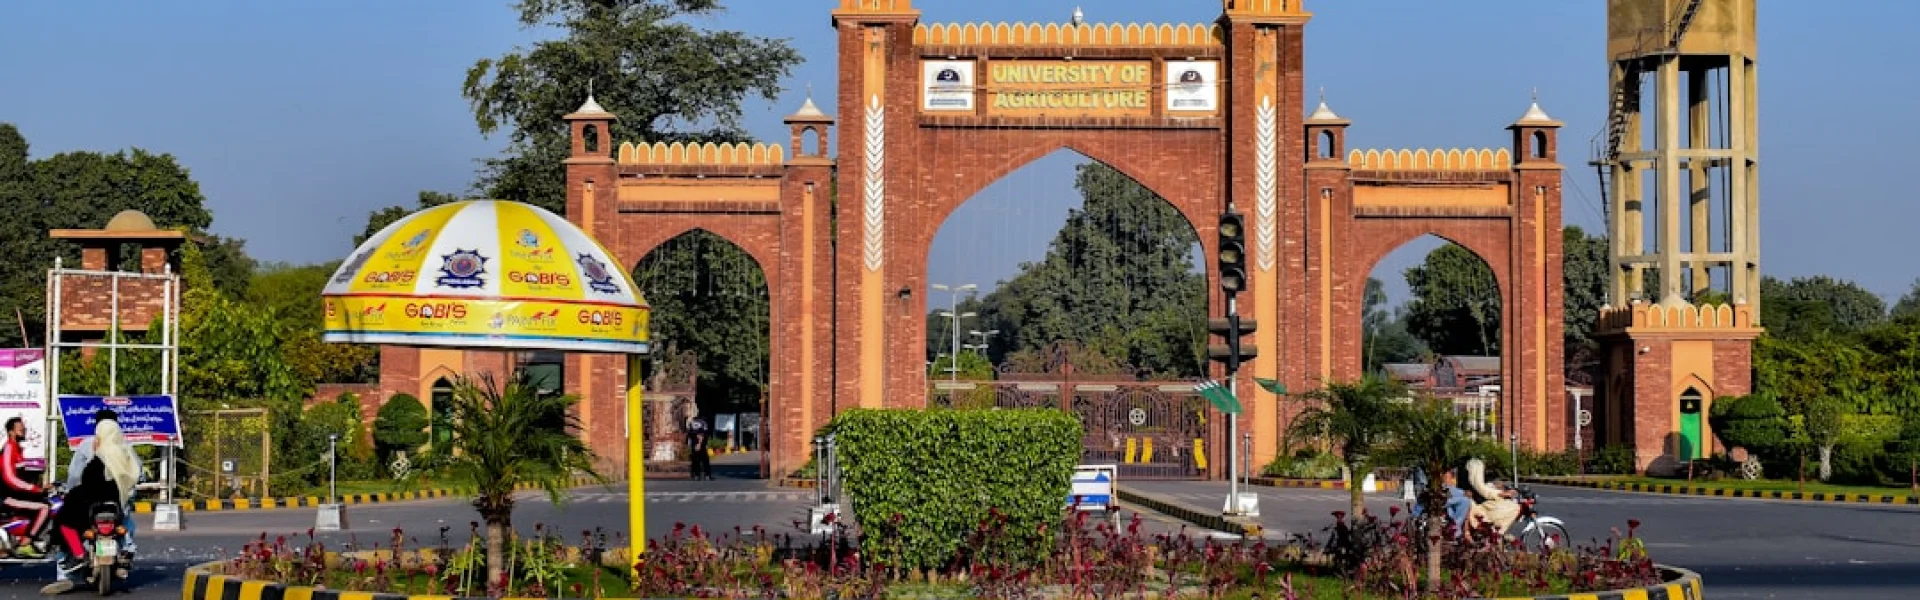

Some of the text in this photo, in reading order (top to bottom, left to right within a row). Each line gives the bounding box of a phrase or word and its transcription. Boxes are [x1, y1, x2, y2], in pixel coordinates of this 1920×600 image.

[993, 63, 1148, 83] UNIVERSITY OF
[993, 90, 1147, 109] AGRICULTURE
[508, 271, 570, 286] GOBI'S
[404, 302, 467, 319] GOBI'S
[578, 310, 623, 326] GOBI'S
